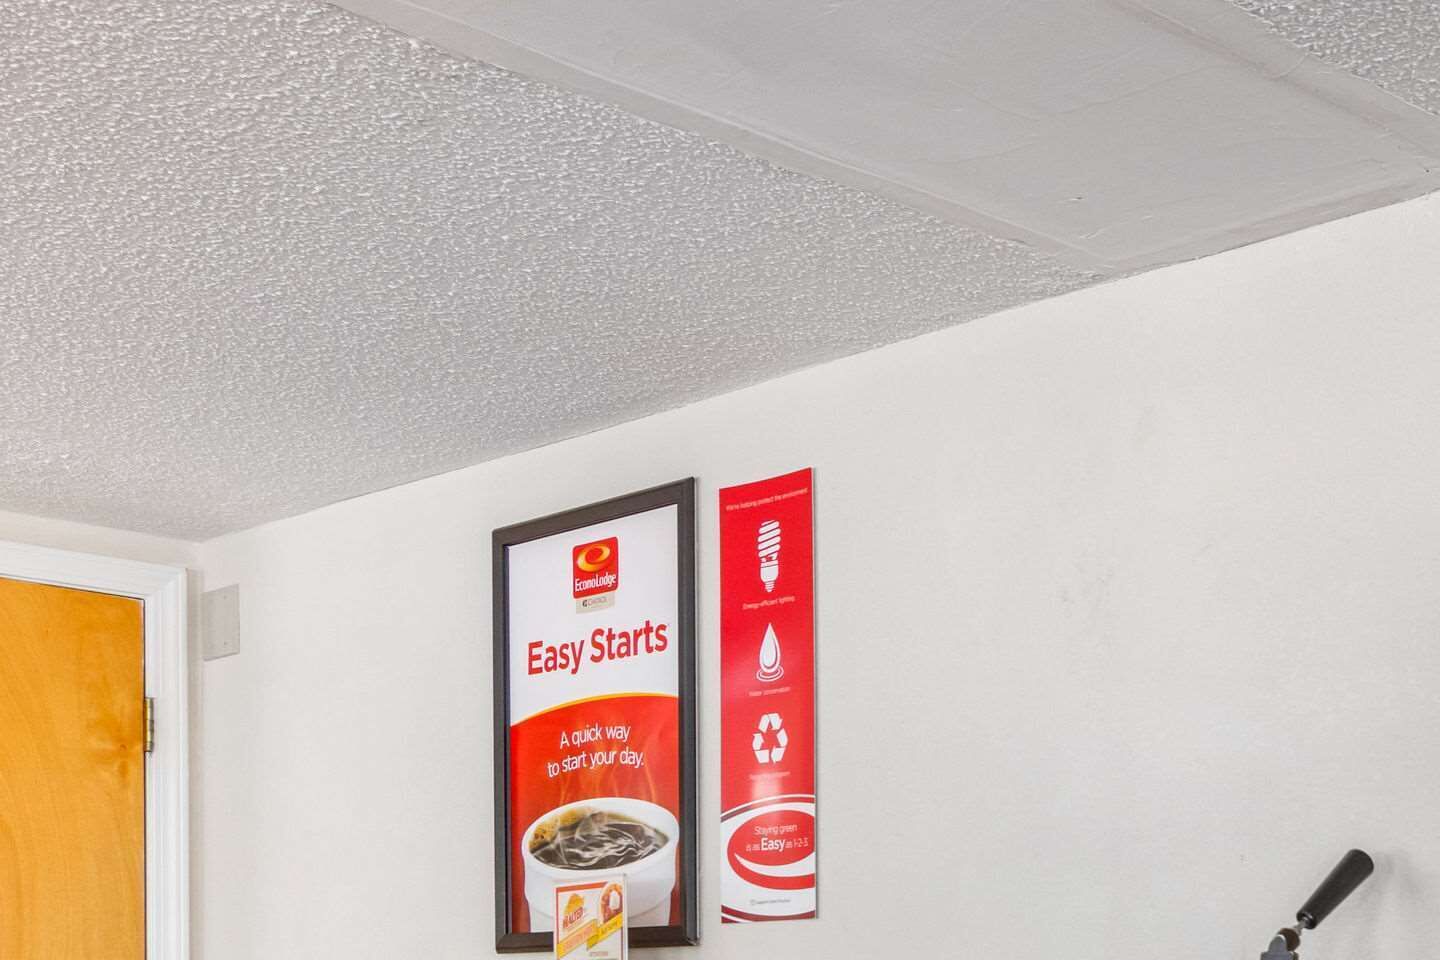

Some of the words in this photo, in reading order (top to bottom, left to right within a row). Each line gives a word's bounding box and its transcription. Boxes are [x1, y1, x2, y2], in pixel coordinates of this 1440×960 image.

[528, 640, 585, 676] Easy
[590, 619, 668, 663] Starts
[560, 731, 570, 750] A
[571, 722, 602, 748] quick
[605, 725, 631, 743] way
[547, 761, 560, 778] to
[561, 750, 587, 773] start
[589, 750, 617, 769] your
[619, 746, 644, 769] day.
[761, 837, 786, 852] Easy
